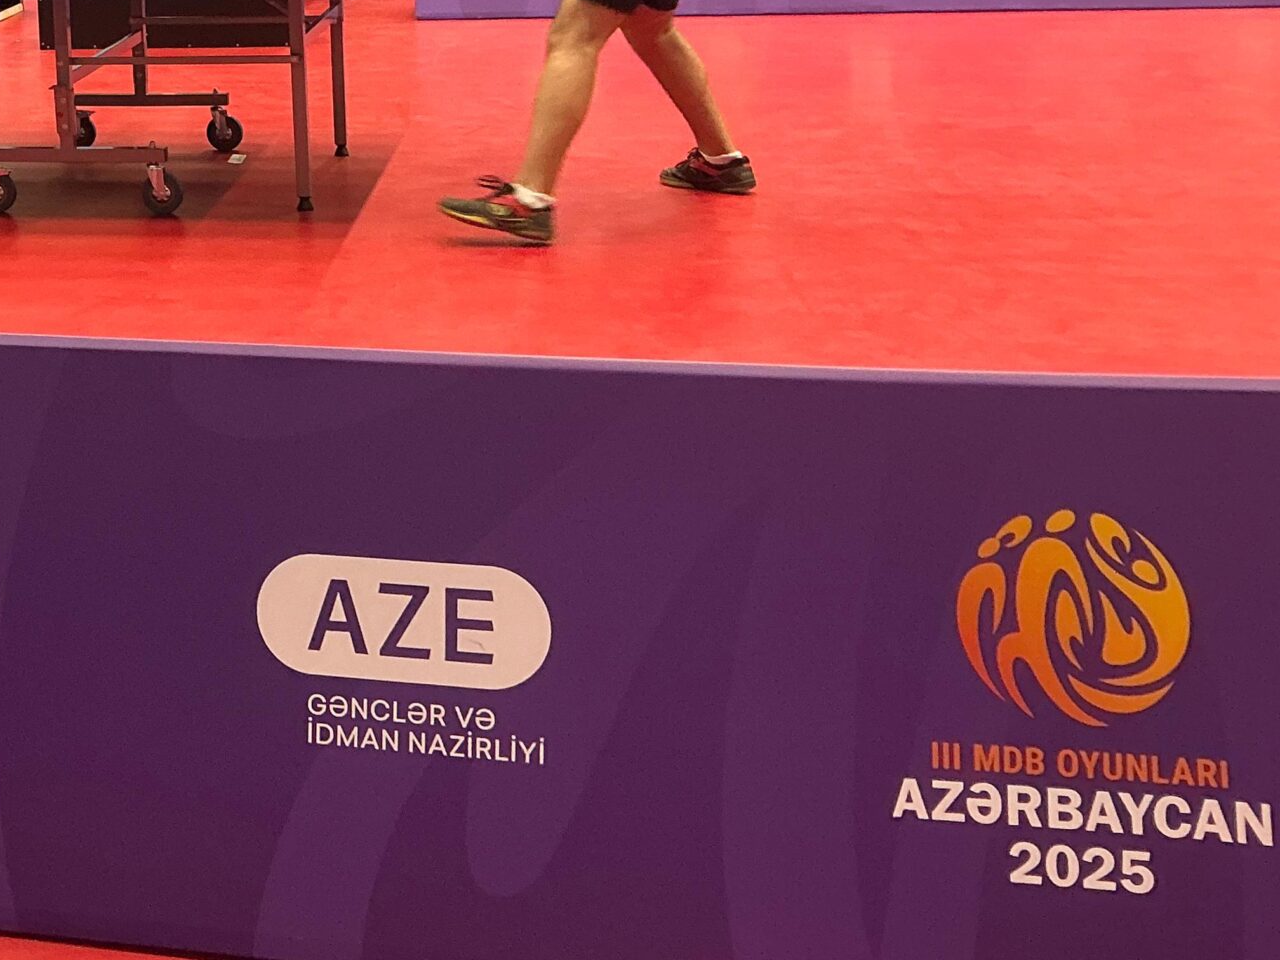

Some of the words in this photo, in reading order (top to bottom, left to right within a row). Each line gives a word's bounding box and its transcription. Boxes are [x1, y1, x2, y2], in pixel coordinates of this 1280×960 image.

[308, 579, 495, 665] AZE
[307, 694, 447, 728] GƏNCLƏR
[455, 706, 497, 731] VƏ
[307, 717, 400, 753] İDMAN
[408, 730, 546, 766] NAZİRLİYİ
[931, 740, 962, 771] III
[973, 743, 1046, 777] MDB
[1056, 749, 1230, 790] OYUNLARI
[892, 776, 1275, 848] AZƏRBAYCAN
[1008, 841, 1156, 896] 2025
